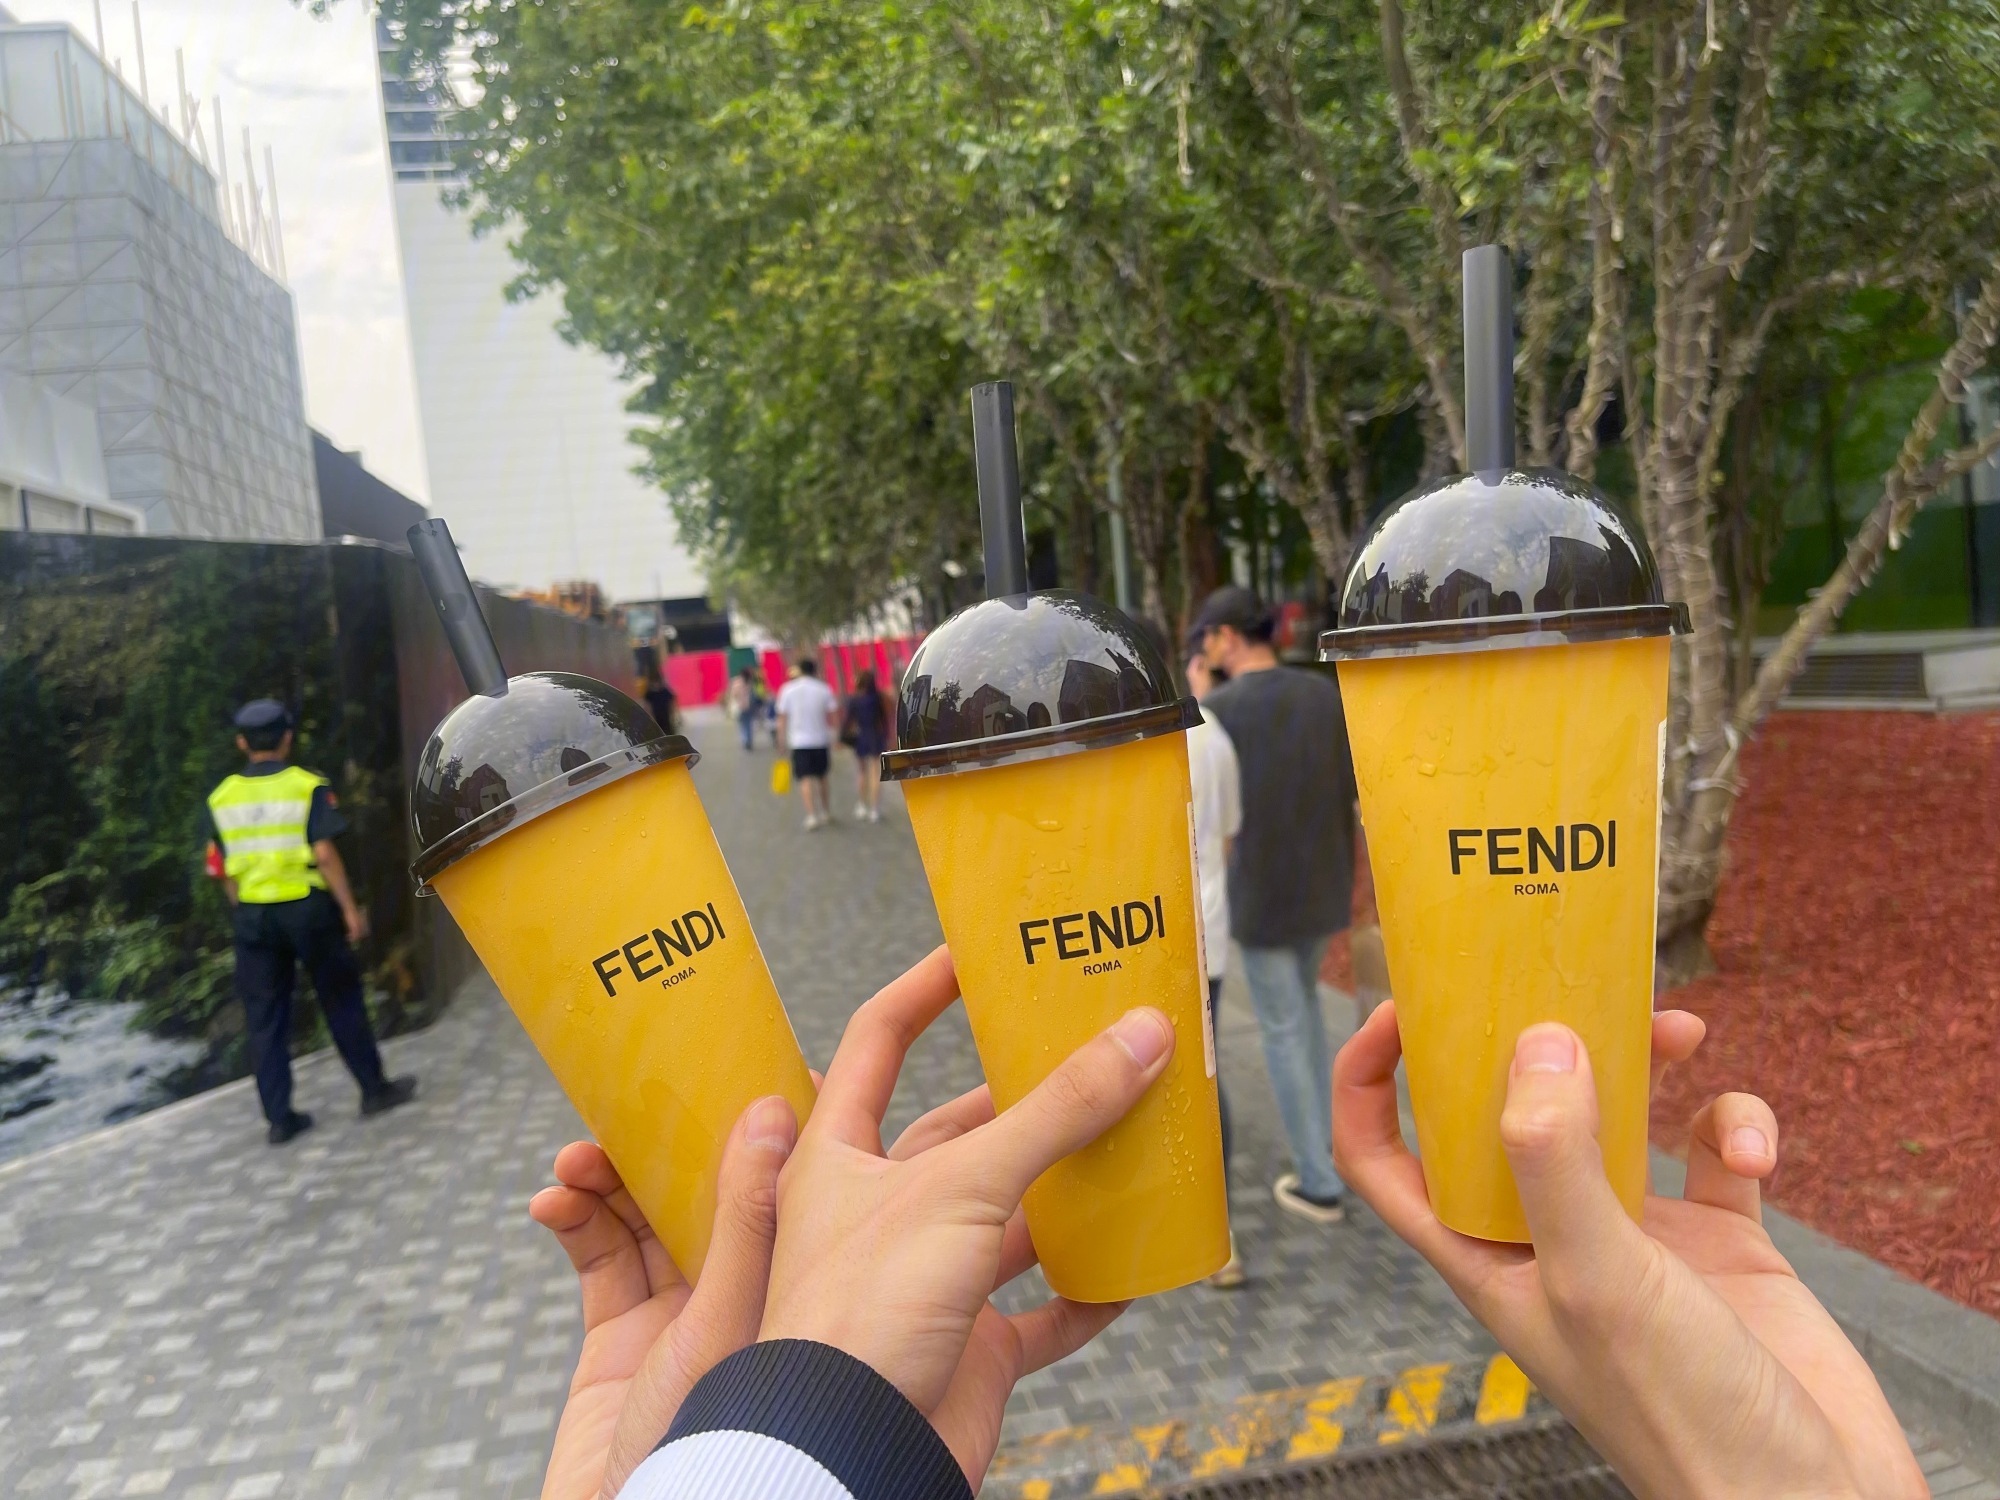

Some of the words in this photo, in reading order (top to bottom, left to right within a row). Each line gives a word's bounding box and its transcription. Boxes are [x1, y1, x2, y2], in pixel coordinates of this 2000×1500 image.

[1448, 819, 1617, 876] FENDI
[1513, 882, 1560, 896] ROMA
[1019, 894, 1167, 966] FENDI
[592, 902, 727, 999] FENDI
[1082, 959, 1123, 977] ROMA
[660, 966, 698, 990] ROMA
